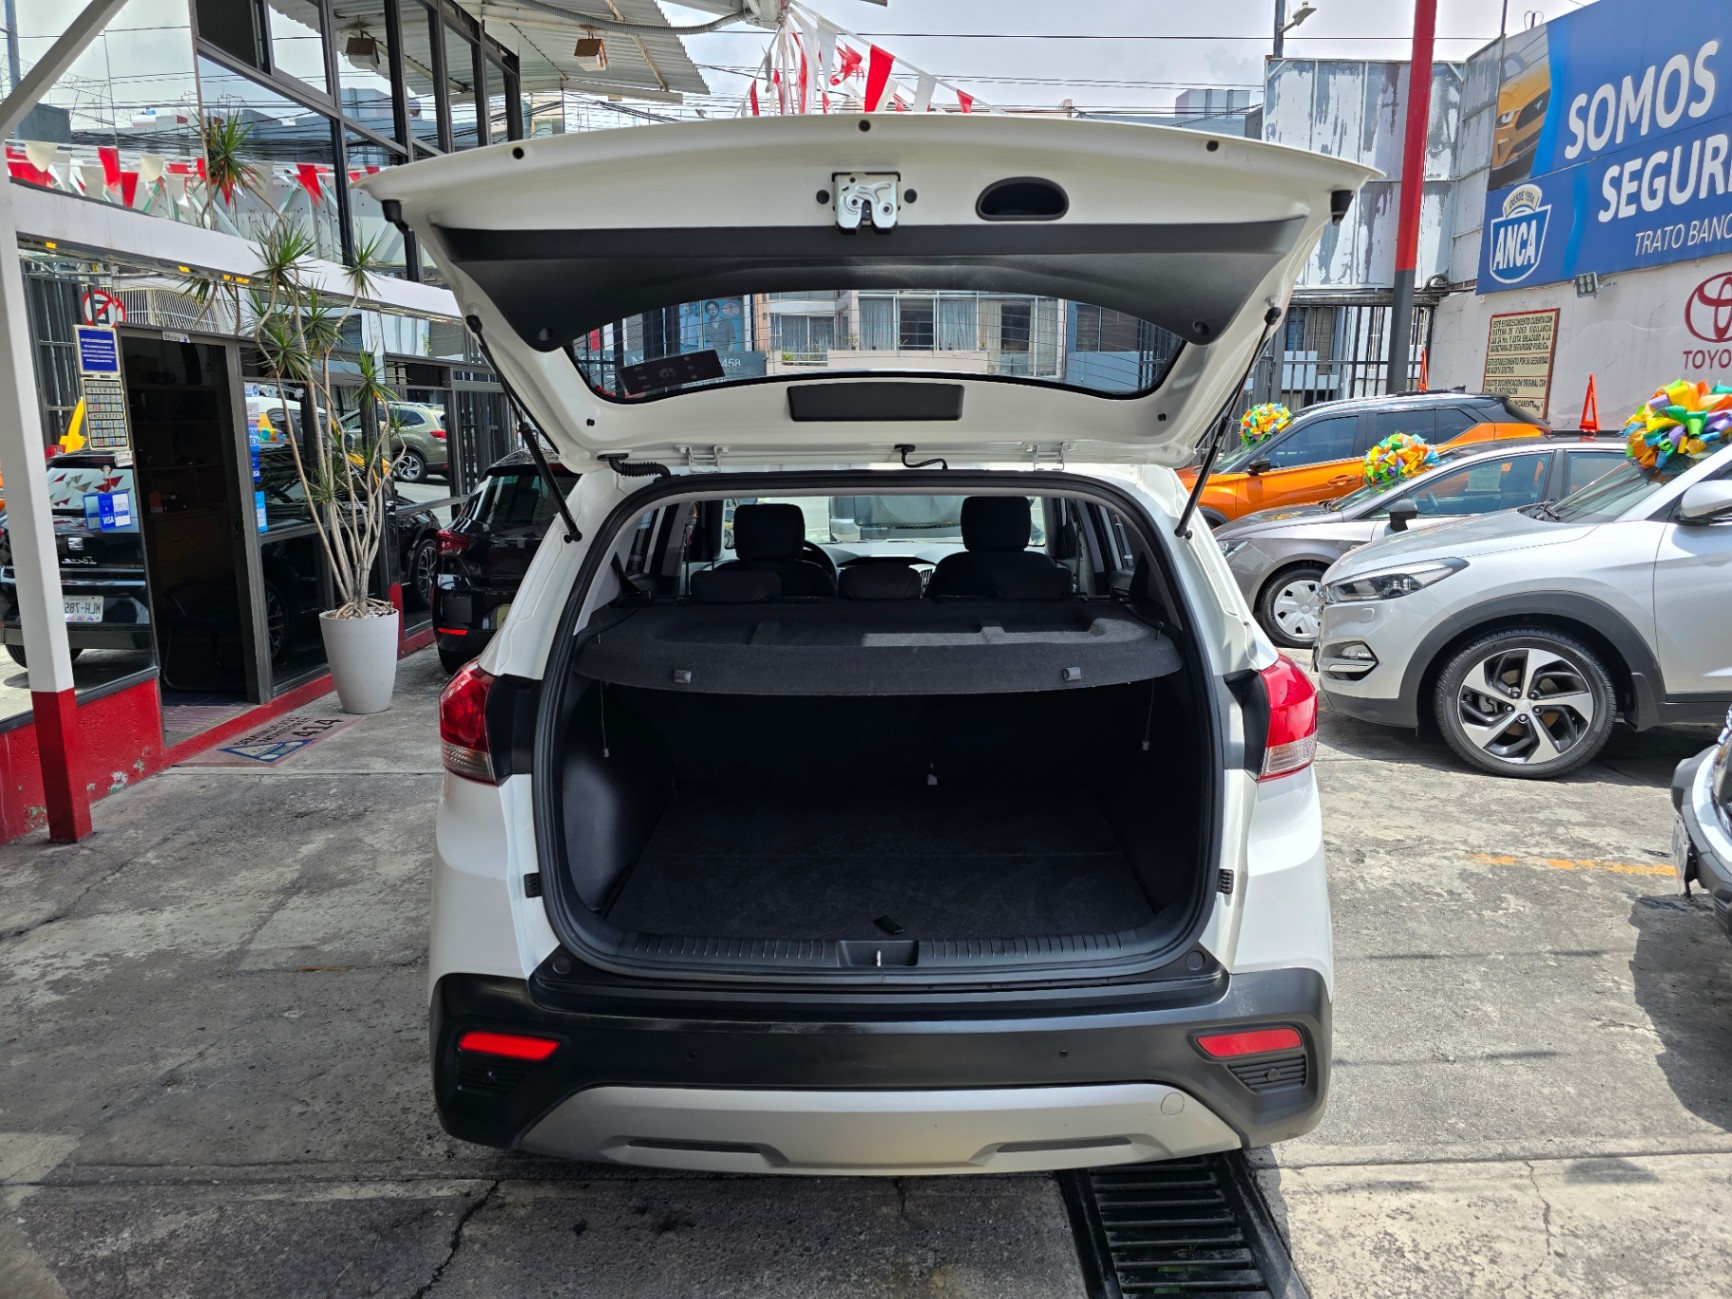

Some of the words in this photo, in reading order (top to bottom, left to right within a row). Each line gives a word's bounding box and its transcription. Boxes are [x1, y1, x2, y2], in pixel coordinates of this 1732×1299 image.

[1564, 40, 1719, 159] SOMOS
[1493, 219, 1537, 270] ANCA
[1635, 223, 1685, 256] TRATO
[1683, 349, 1731, 369] TOYO
[102, 515, 114, 525] VISA
